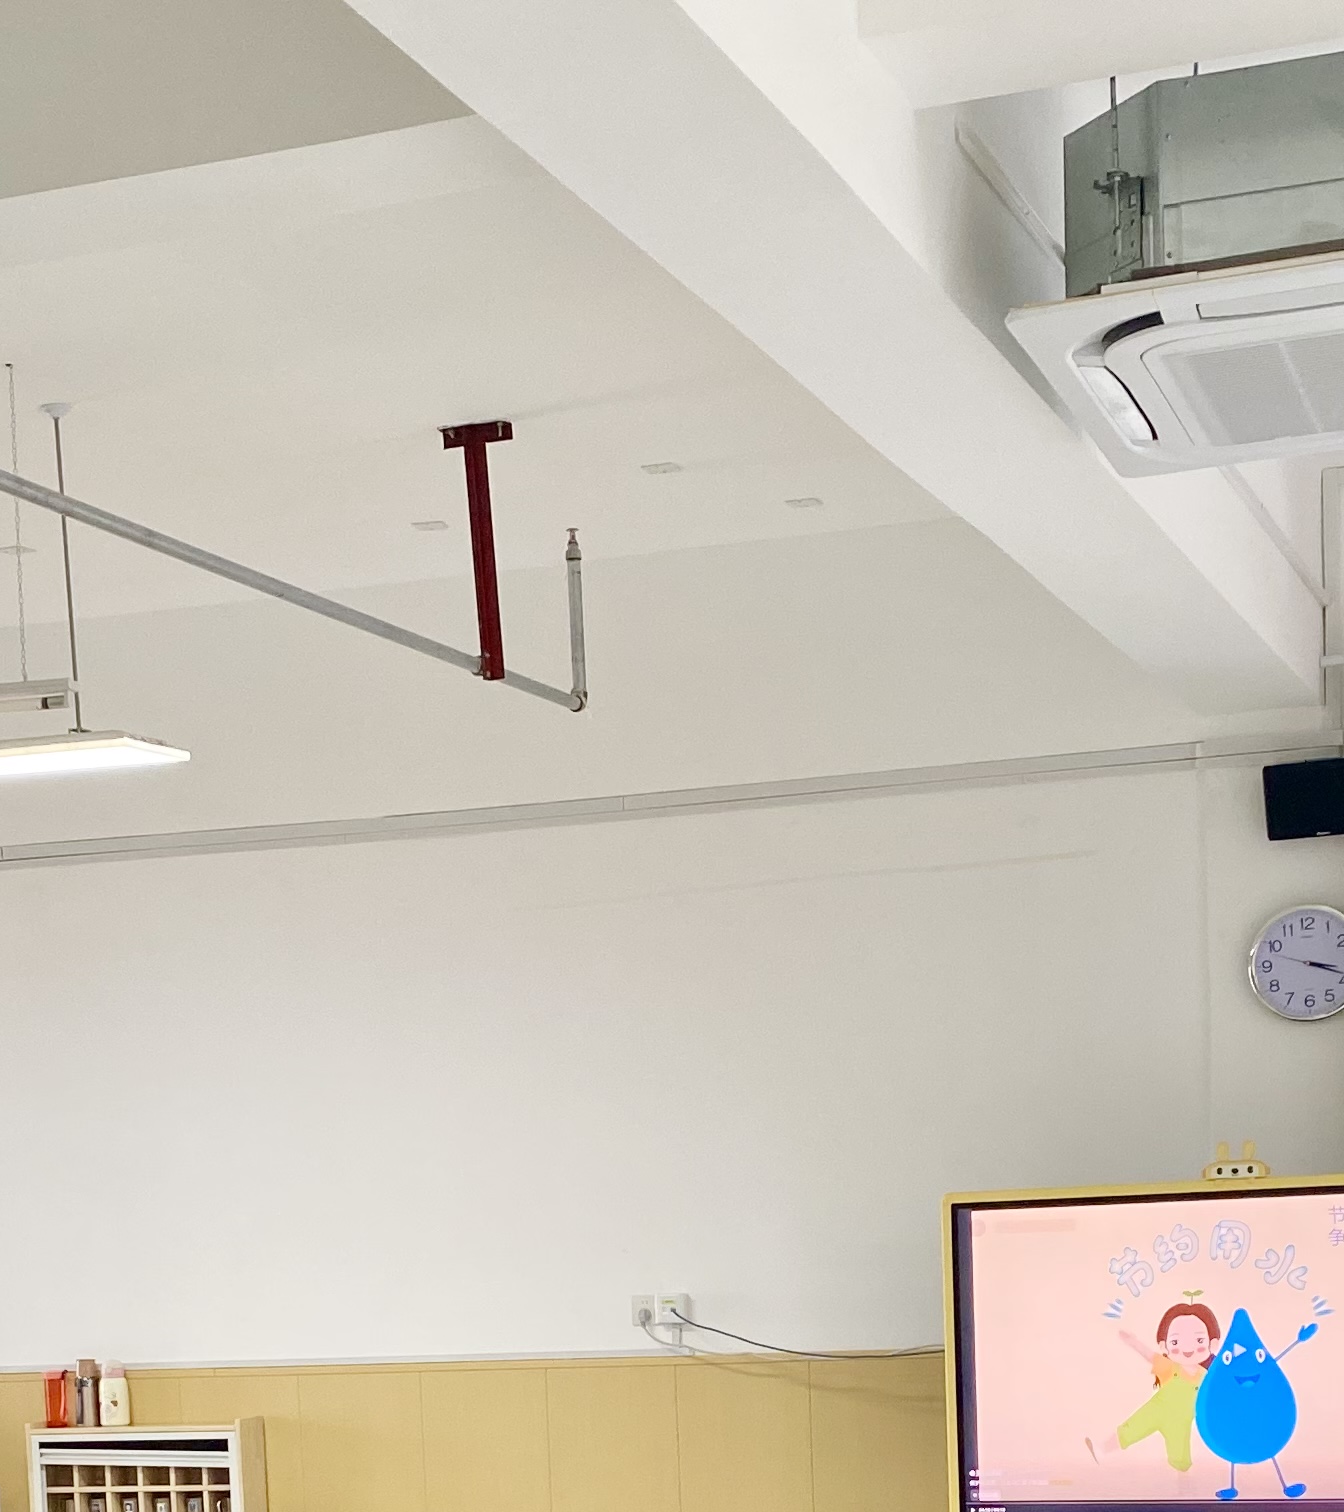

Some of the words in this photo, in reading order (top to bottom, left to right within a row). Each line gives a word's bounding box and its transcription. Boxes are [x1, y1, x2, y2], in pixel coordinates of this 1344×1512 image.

[1282, 923, 1294, 937] 11
[1300, 916, 1315, 931] 12
[1325, 920, 1330, 934] 1
[1268, 939, 1283, 953] 10
[1261, 960, 1273, 973] 9
[1269, 979, 1280, 993] 8
[1285, 991, 1295, 1006] 7
[1304, 994, 1316, 1008] 6
[1324, 988, 1335, 1002] 5
[1109, 1219, 1308, 1297] 节约用水
